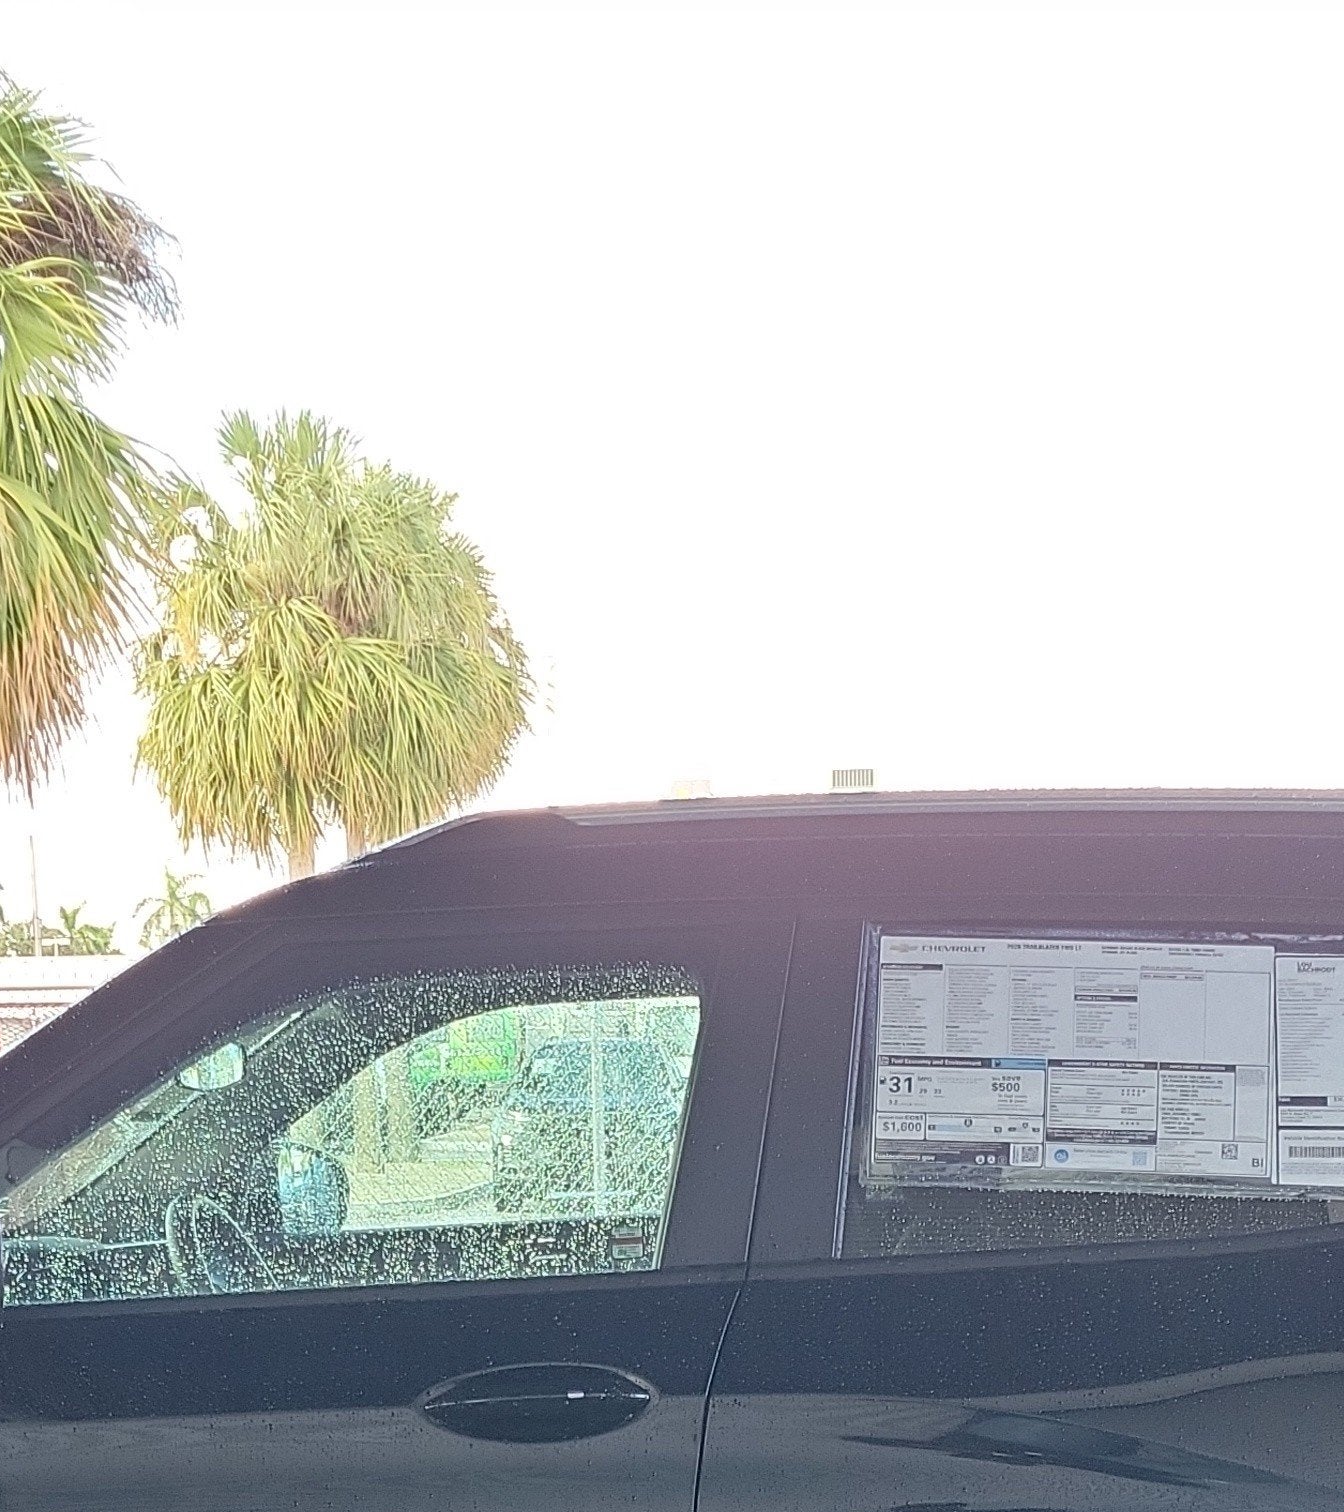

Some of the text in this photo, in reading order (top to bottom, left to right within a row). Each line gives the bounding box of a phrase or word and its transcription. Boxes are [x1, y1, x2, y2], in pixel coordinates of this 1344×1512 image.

[922, 944, 985, 953] CHEVROLET
[888, 1076, 913, 1094] 31
[992, 1082, 1020, 1092] $500
[883, 1121, 922, 1133] $1,600
